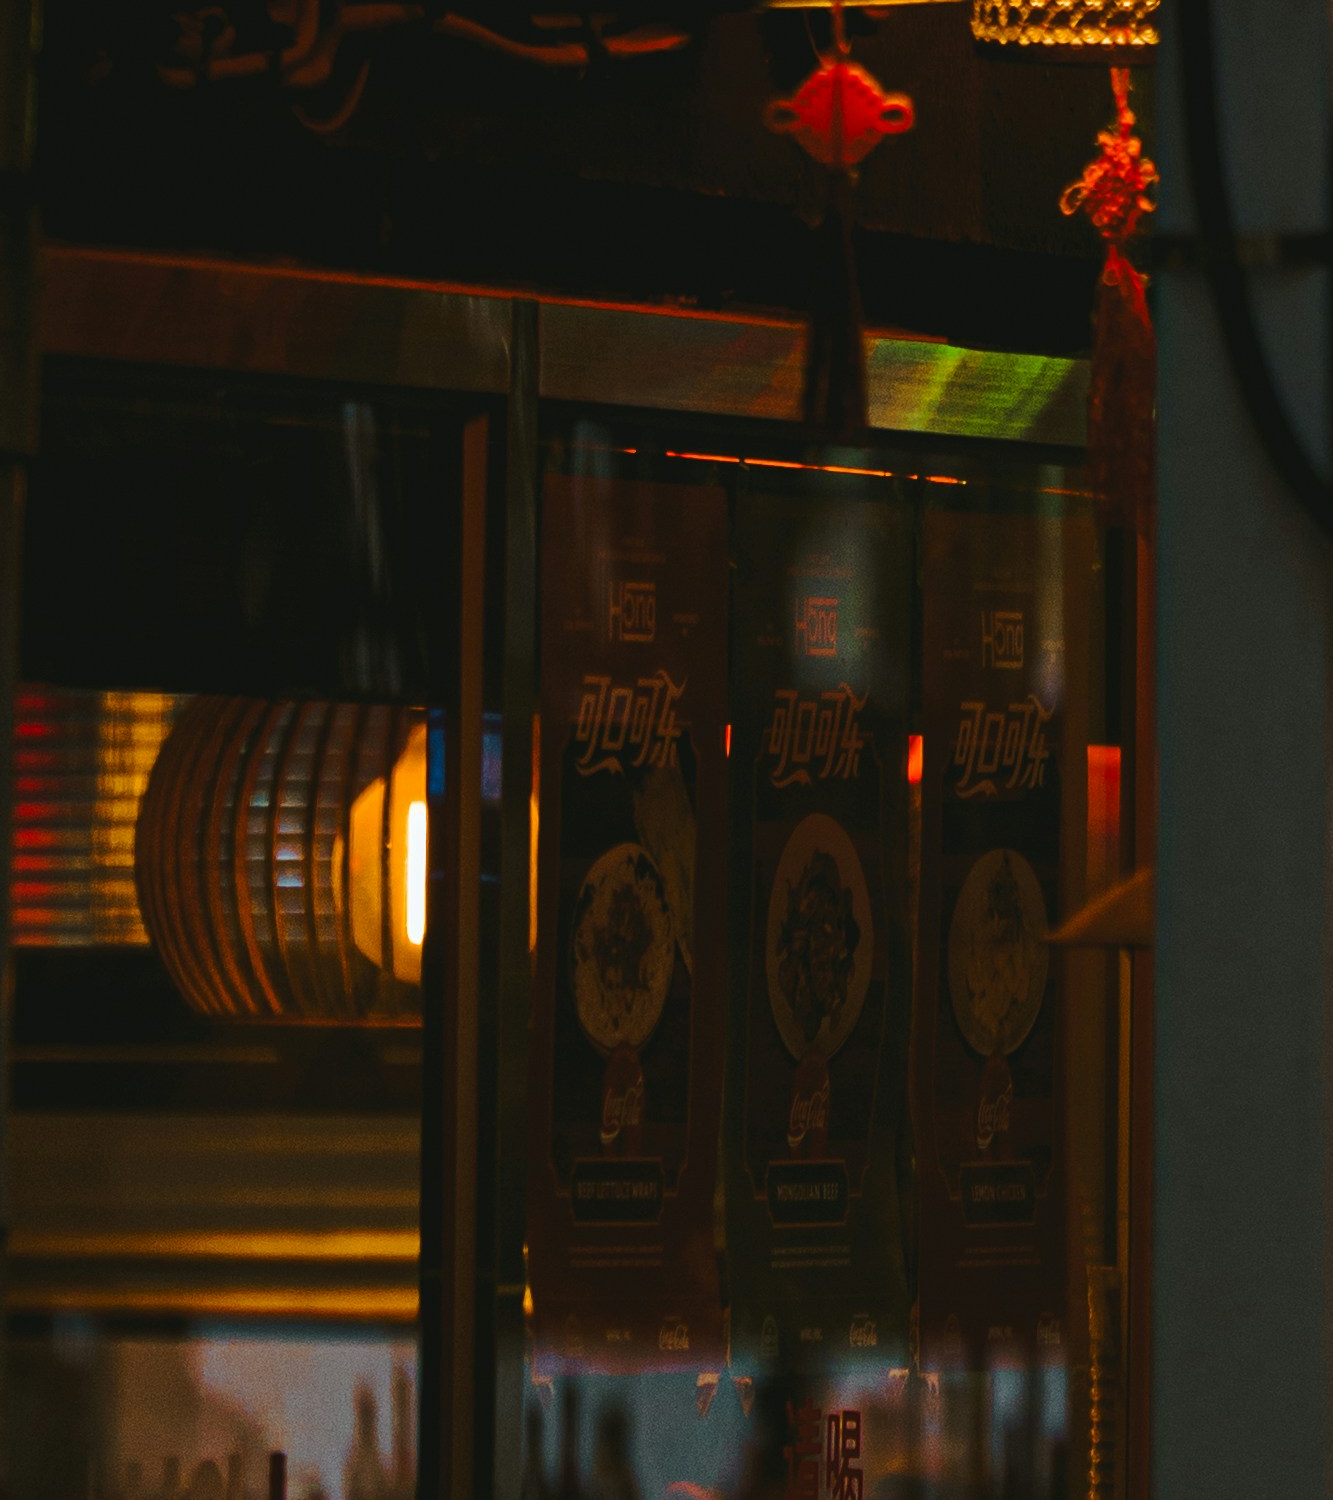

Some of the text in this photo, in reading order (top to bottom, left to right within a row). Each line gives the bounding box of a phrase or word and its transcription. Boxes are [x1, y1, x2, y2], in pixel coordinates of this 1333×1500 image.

[777, 1182, 839, 1201] MONGOLIAN BEEF
[971, 1184, 1026, 1202] LEMON CHICKEN
